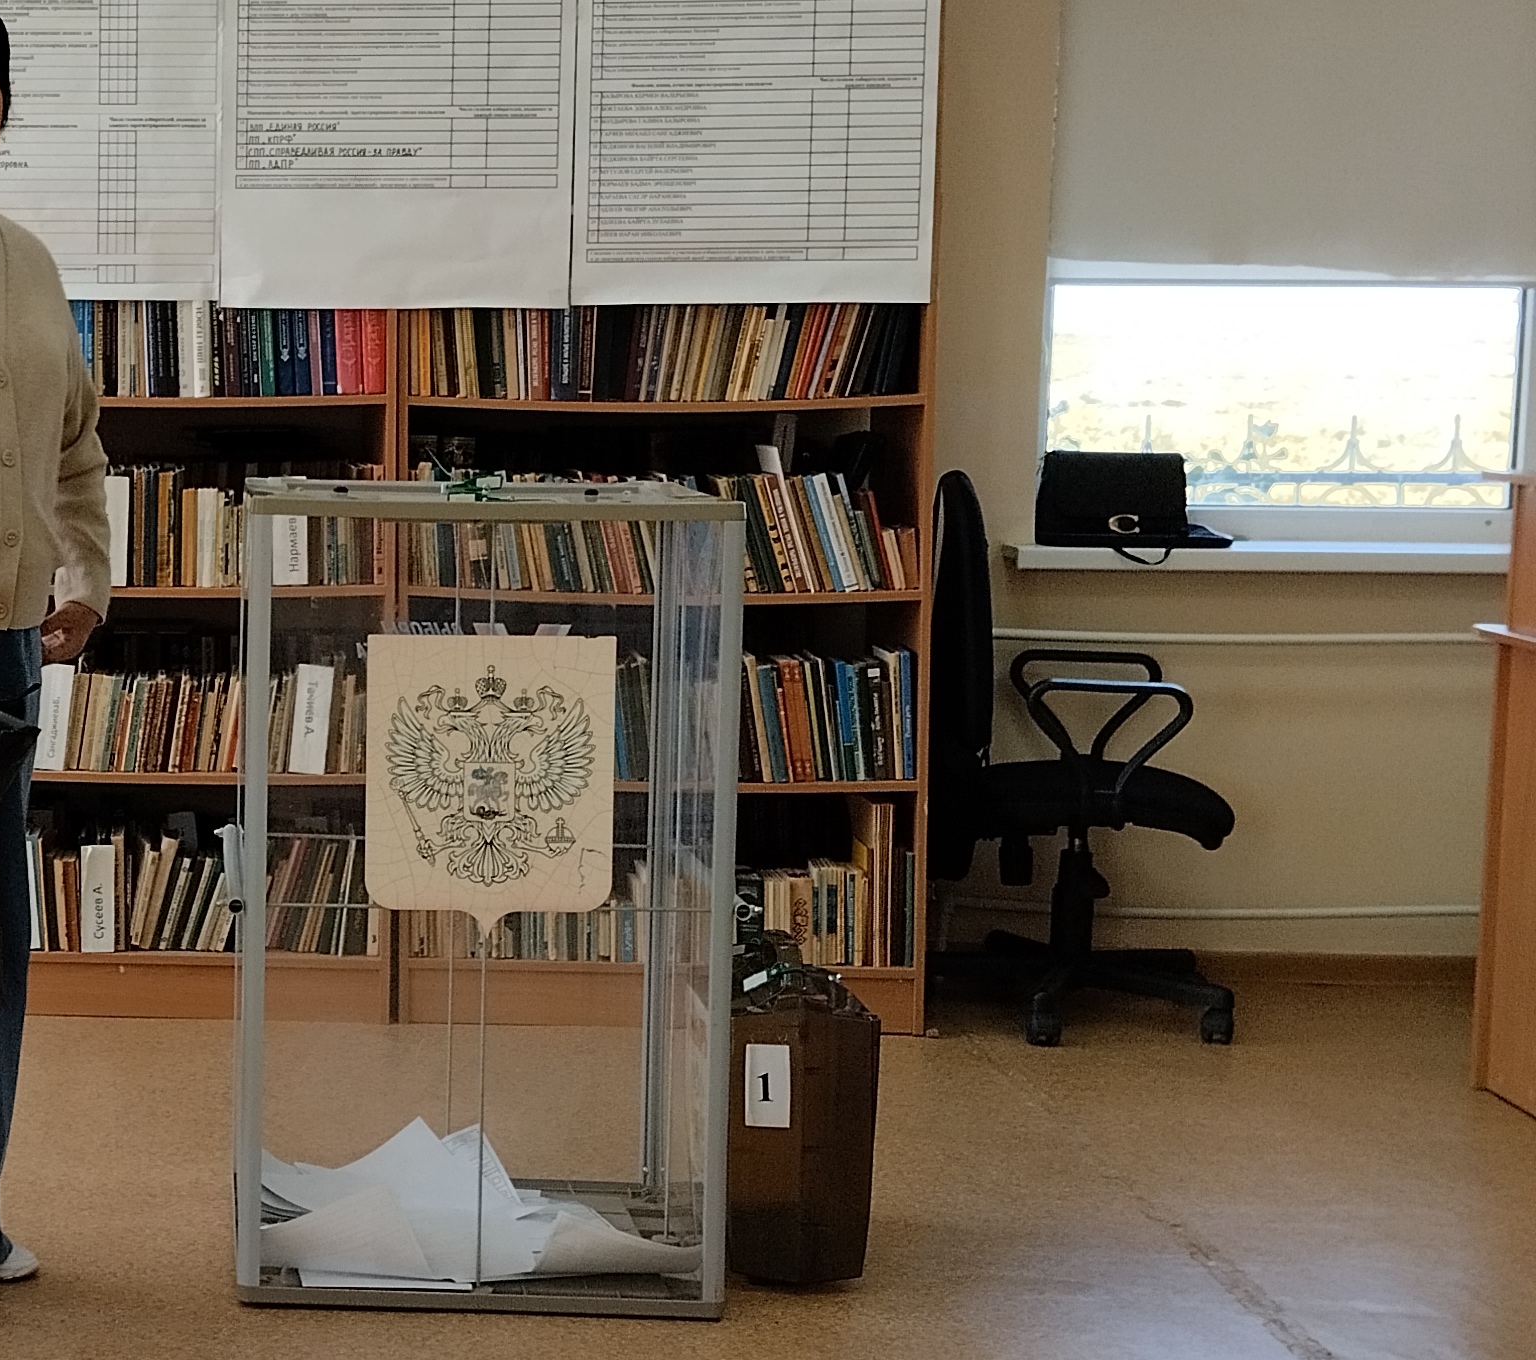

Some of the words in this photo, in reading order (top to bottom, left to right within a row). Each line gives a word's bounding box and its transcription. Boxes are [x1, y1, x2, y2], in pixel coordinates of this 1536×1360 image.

[288, 517, 301, 573] Нармаев
[93, 896, 107, 940] Сусеев
[756, 1072, 774, 1103] 1
